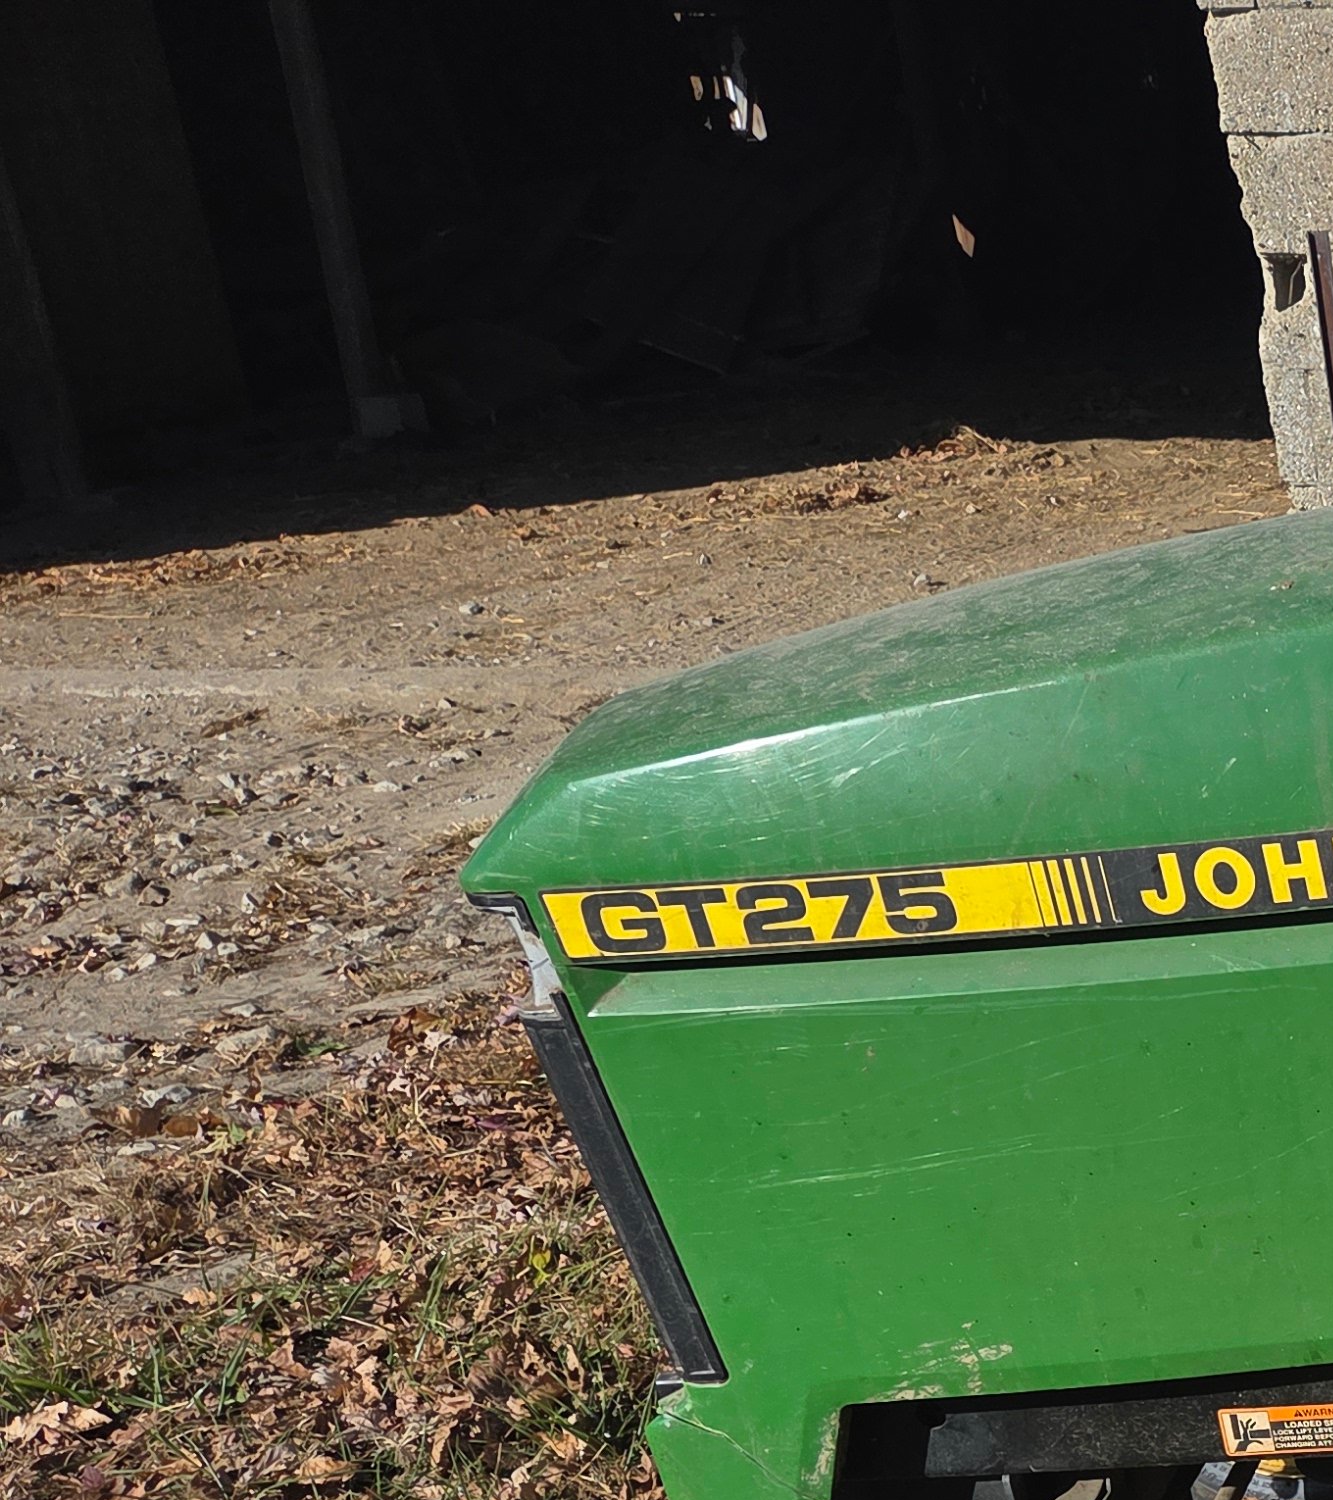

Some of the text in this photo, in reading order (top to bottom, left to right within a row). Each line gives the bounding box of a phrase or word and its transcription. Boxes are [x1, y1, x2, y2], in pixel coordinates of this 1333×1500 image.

[580, 872, 958, 954] GT275
[1284, 1420, 1322, 1429] LOADED
[1273, 1428, 1294, 1436] LOCK
[1274, 1434, 1313, 1442] FORWARD
